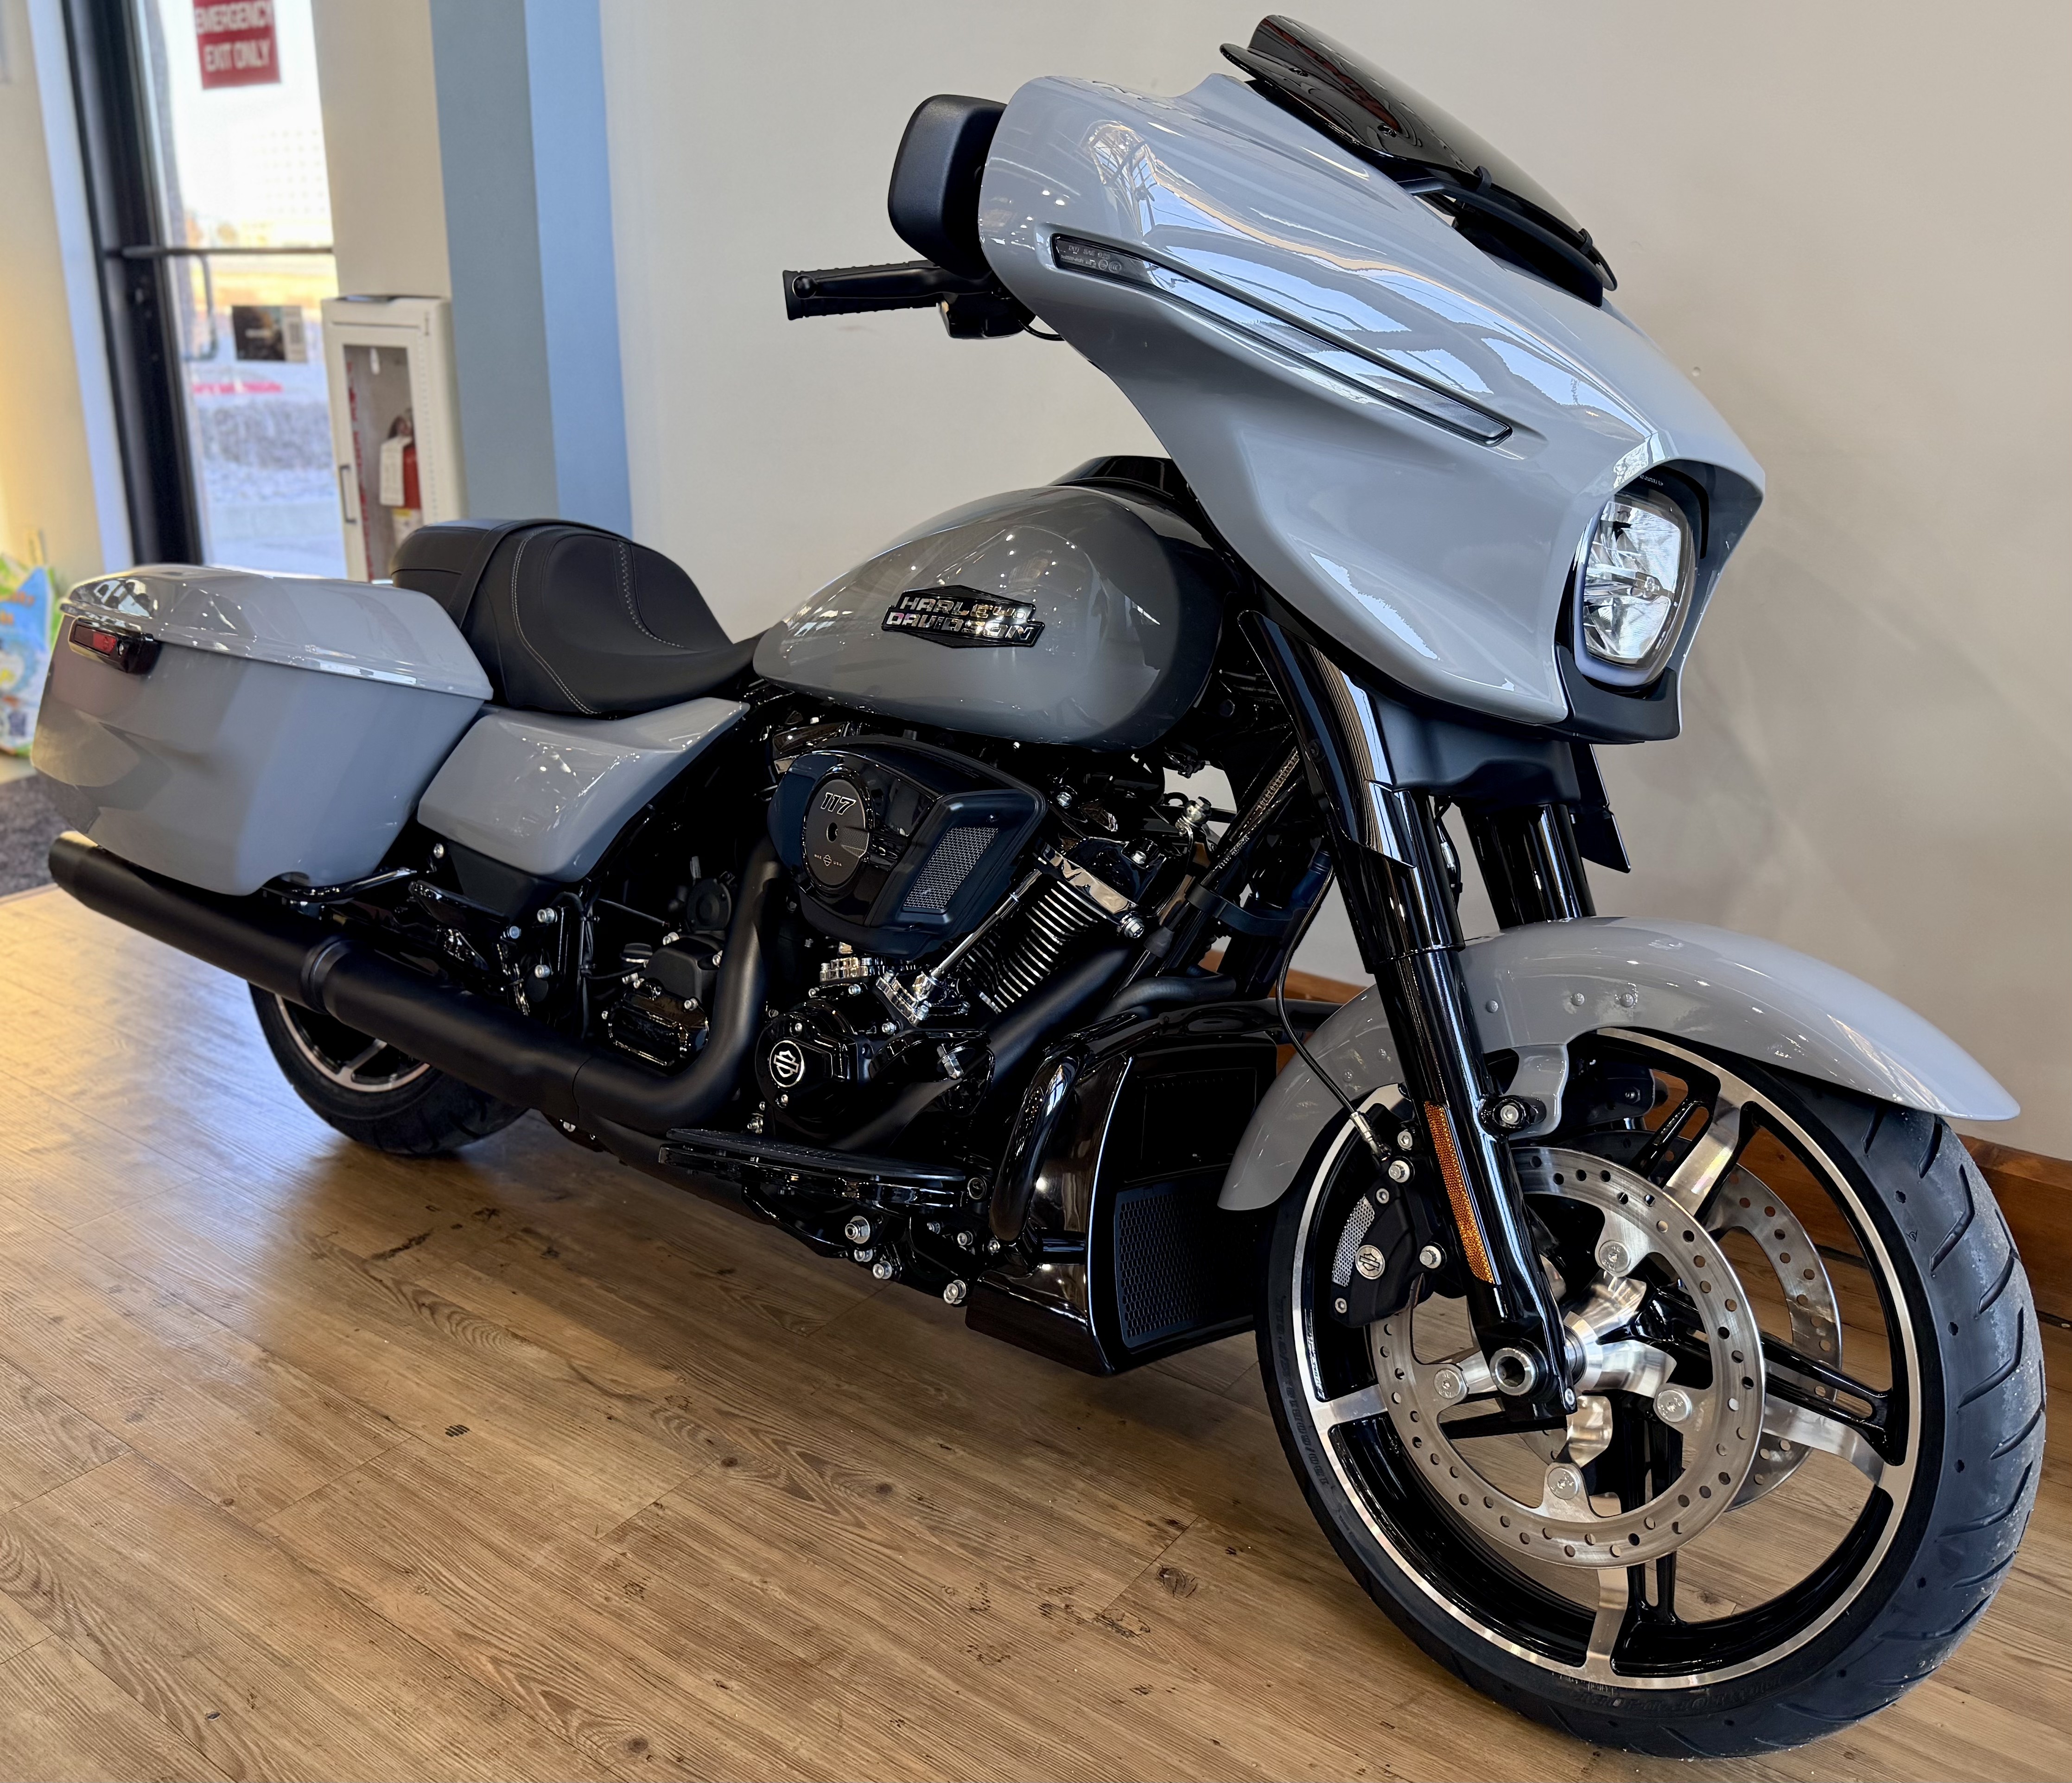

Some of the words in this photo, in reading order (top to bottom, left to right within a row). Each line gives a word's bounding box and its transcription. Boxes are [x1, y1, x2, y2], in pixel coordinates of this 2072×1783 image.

[195, 1, 273, 34] EMERGENCY
[204, 42, 232, 72] EXIT
[233, 38, 270, 69] ONLY
[886, 612, 1034, 640] DAVIDSON
[820, 792, 857, 815] 117
